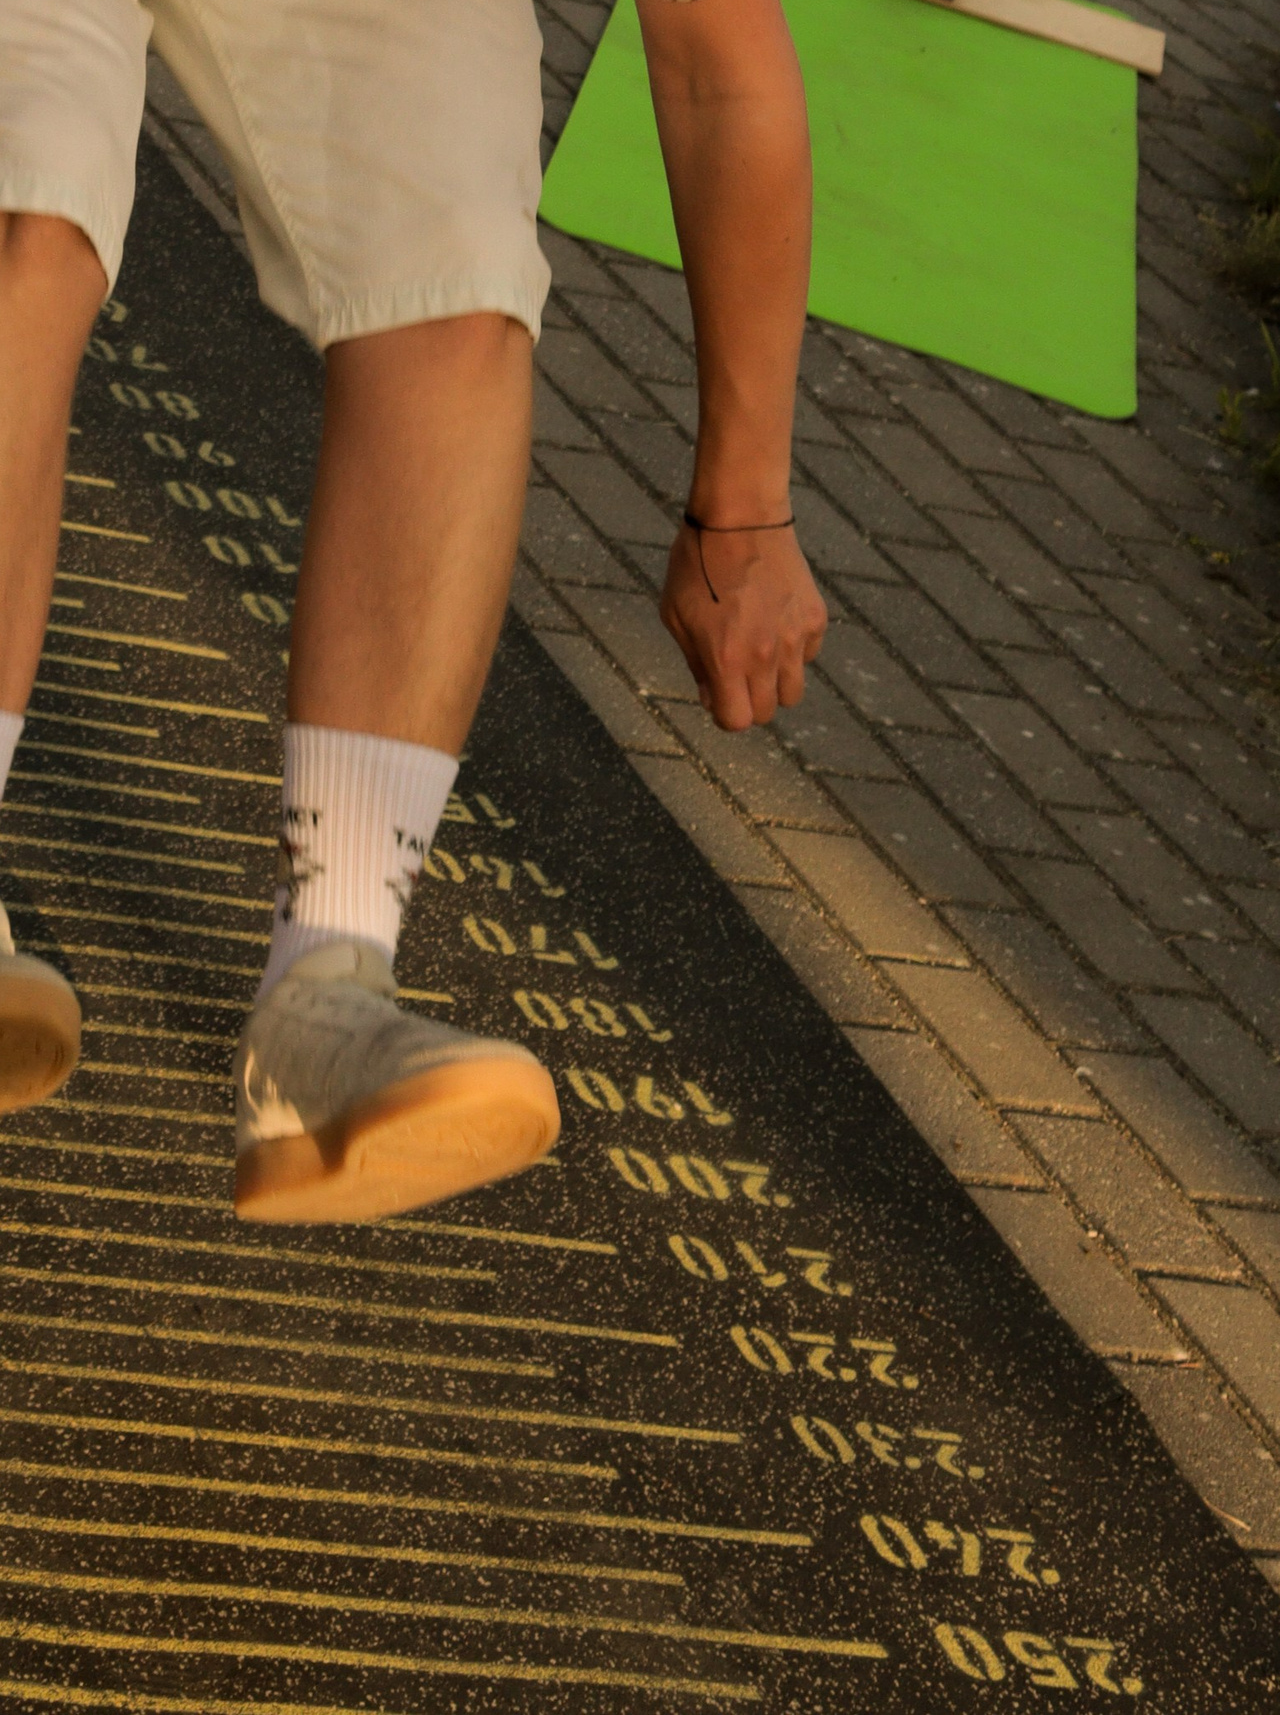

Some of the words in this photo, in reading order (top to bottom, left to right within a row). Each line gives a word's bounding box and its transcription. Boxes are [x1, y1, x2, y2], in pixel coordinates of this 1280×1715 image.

[108, 381, 200, 422] 80
[142, 430, 236, 467] 90
[164, 479, 302, 528] 100
[201, 533, 299, 574] 10
[441, 791, 517, 830] 15
[424, 846, 567, 900] 160
[459, 914, 619, 971] 170
[510, 987, 674, 1044] 180
[566, 1067, 734, 1128] 190
[608, 1146, 796, 1209] 200
[666, 1232, 854, 1299] 210
[728, 1324, 920, 1391] 220
[789, 1415, 986, 1481] 230
[859, 1513, 1061, 1586] 240
[933, 1621, 1144, 1697] 250
